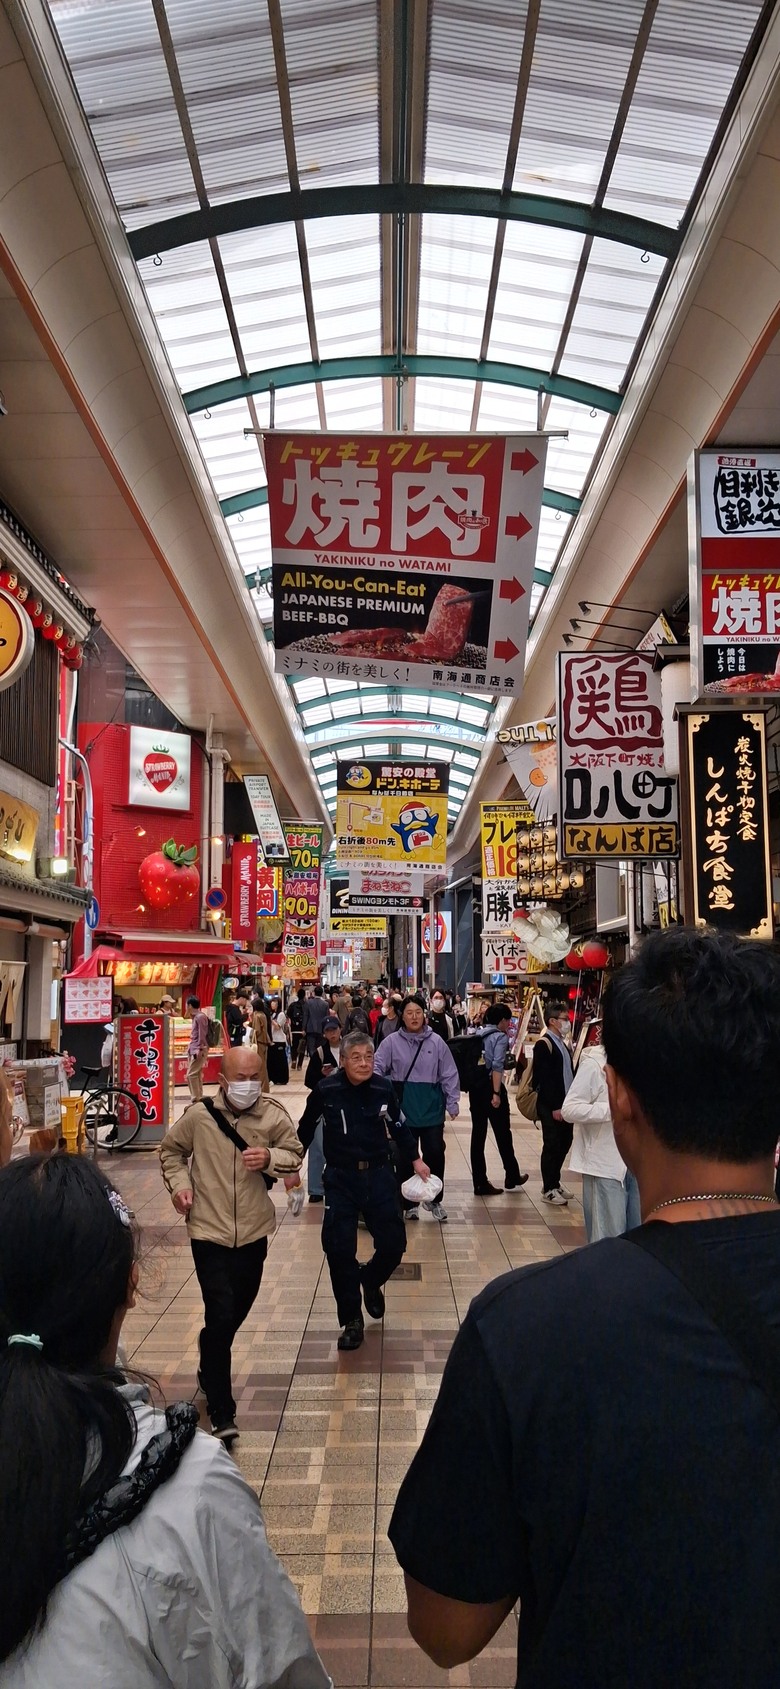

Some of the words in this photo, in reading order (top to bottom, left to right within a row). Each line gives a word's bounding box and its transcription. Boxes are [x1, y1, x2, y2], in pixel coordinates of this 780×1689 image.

[280, 441, 492, 467] トッキュウレーン
[282, 459, 486, 556] 焼肉
[314, 553, 376, 568] YAKINIKU
[379, 558, 395, 569] no
[398, 559, 452, 572] WATAMI
[281, 572, 427, 597] All-You-Can-Eat
[281, 593, 353, 609] JAPANESE
[357, 598, 425, 615] PREMIUM
[282, 610, 349, 627] BEEF-BBQ
[726, 647, 736, 672] 焼肉に
[737, 647, 746, 672] 今日は
[432, 669, 515, 688] 南海通商店会
[575, 657, 664, 738] 鶏
[734, 736, 758, 841] 炭火焼干物定食
[286, 832, 320, 848] 生ビール
[567, 825, 675, 854] なんば店
[702, 757, 735, 910] しんぱち食堂
[285, 882, 318, 896] ハイボール
[361, 878, 412, 894] まねきねこ
[240, 885, 250, 927] STRAWBERRY
[285, 897, 317, 916] 90円
[351, 897, 410, 906] SWINGヨシモト3F
[285, 933, 315, 949] たこ焼き
[286, 953, 316, 967] 500円
